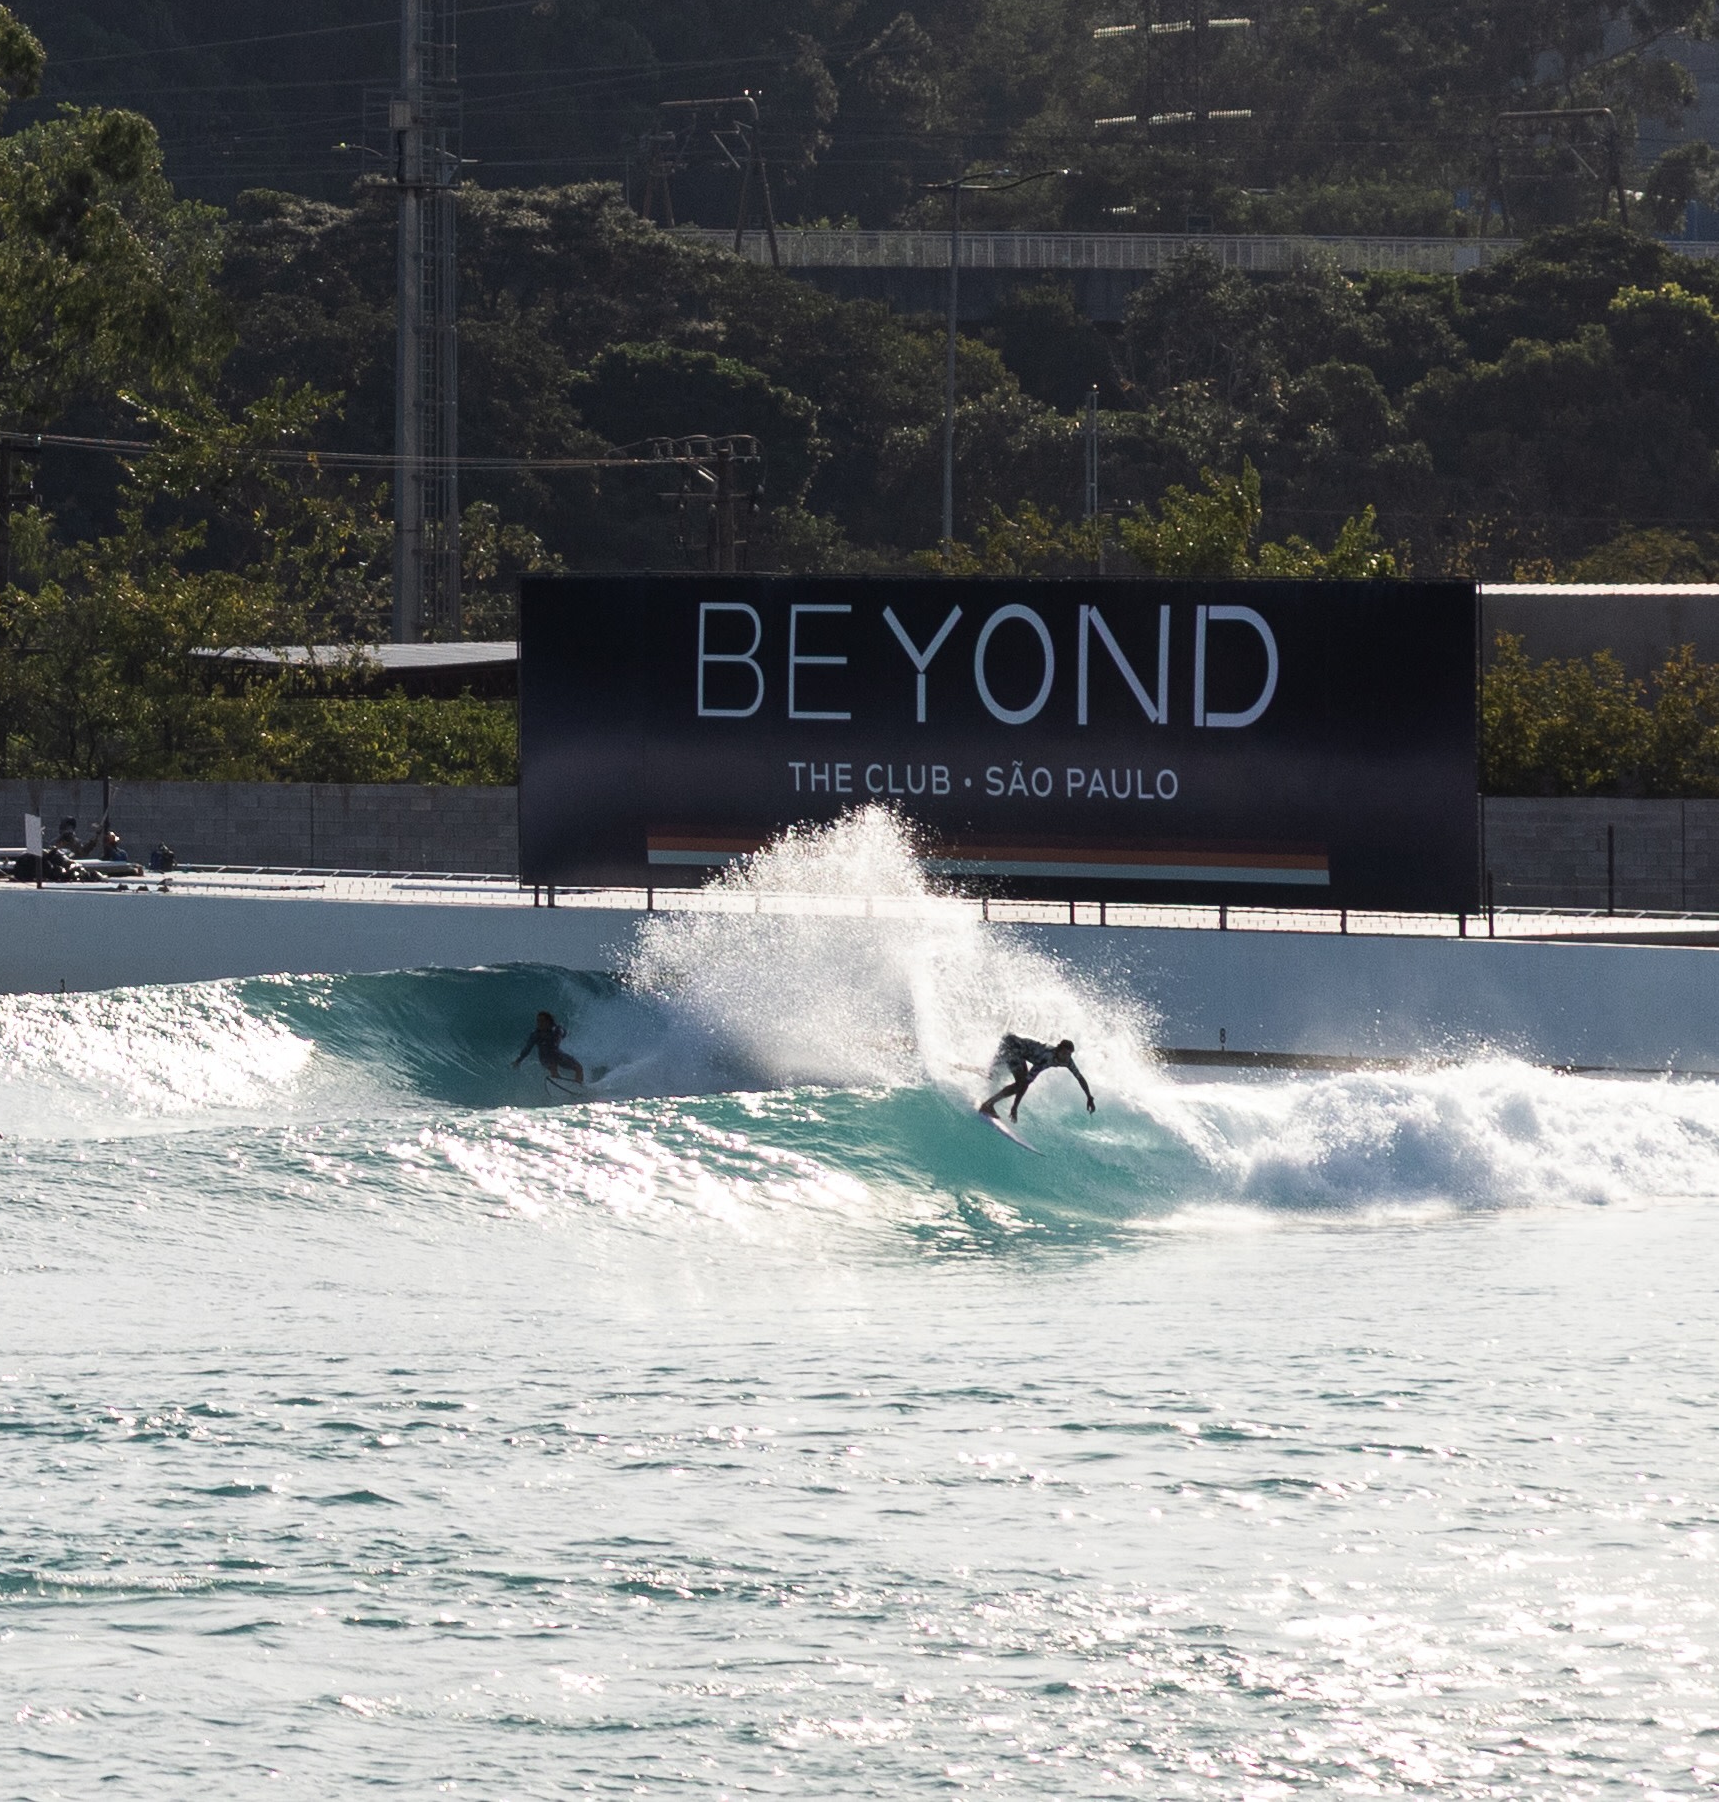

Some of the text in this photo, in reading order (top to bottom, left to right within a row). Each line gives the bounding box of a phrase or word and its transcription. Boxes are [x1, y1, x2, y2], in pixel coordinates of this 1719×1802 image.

[697, 602, 1279, 728] BEYOND
[788, 760, 1179, 800] THE CLUB SÃO PAULO
[1219, 1027, 1226, 1044] 8
